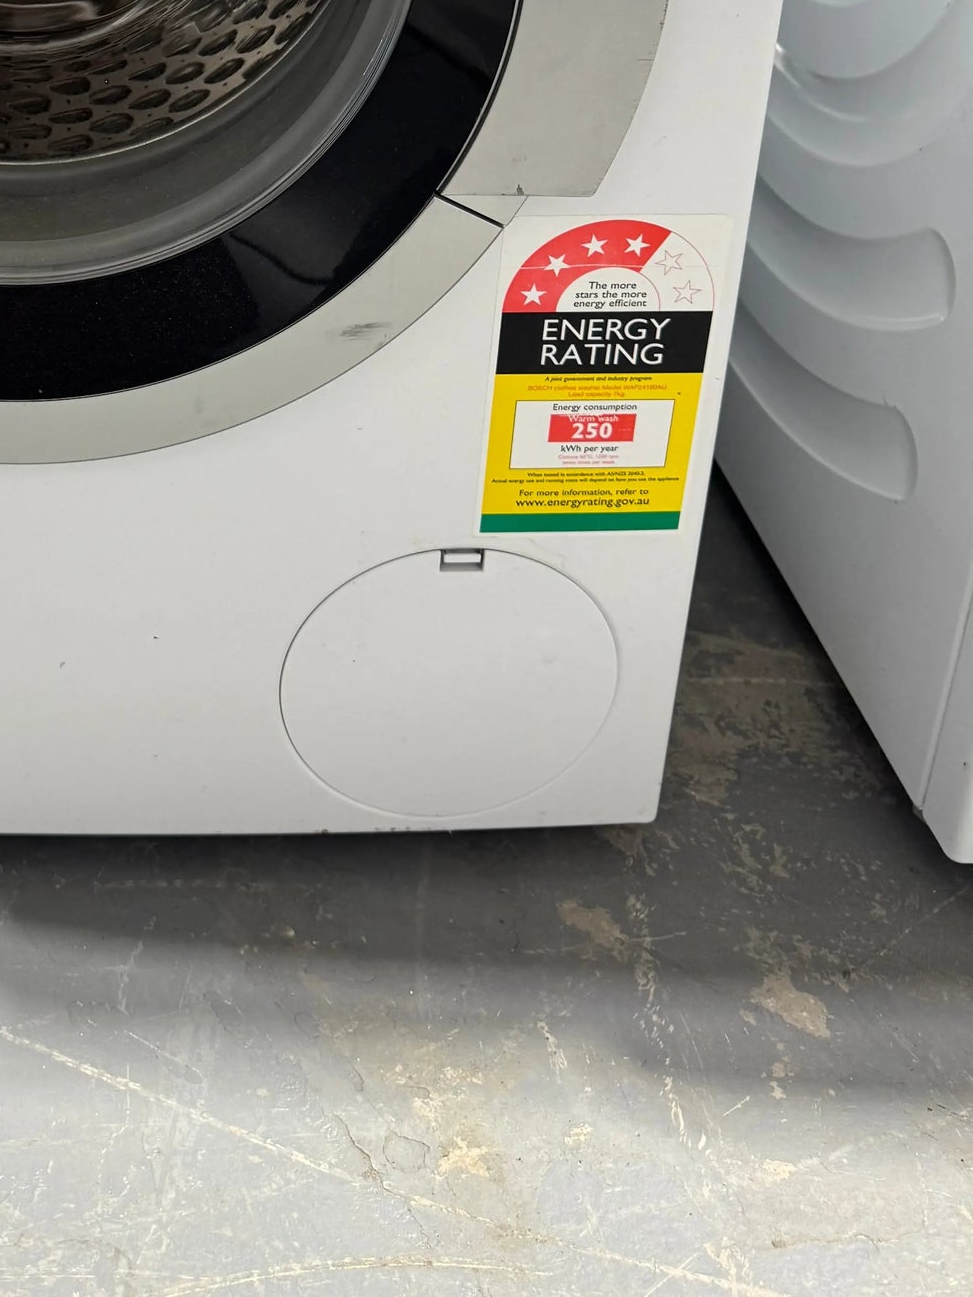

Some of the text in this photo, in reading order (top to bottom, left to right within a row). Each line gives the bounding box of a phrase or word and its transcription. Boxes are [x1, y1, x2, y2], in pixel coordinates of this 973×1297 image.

[589, 281, 607, 290] The
[575, 289, 647, 299] stars the more
[573, 298, 647, 310] energy efficient
[541, 318, 672, 341] ENERGY
[540, 343, 665, 366] RATING
[552, 403, 637, 412] Energy consumption
[571, 422, 613, 439] 250
[584, 446, 598, 454] per
[601, 445, 619, 453] year
[519, 489, 534, 497] For
[561, 488, 613, 497] information,
[615, 488, 637, 496] refer
[516, 498, 650, 508] www.energyrating.gov.au
